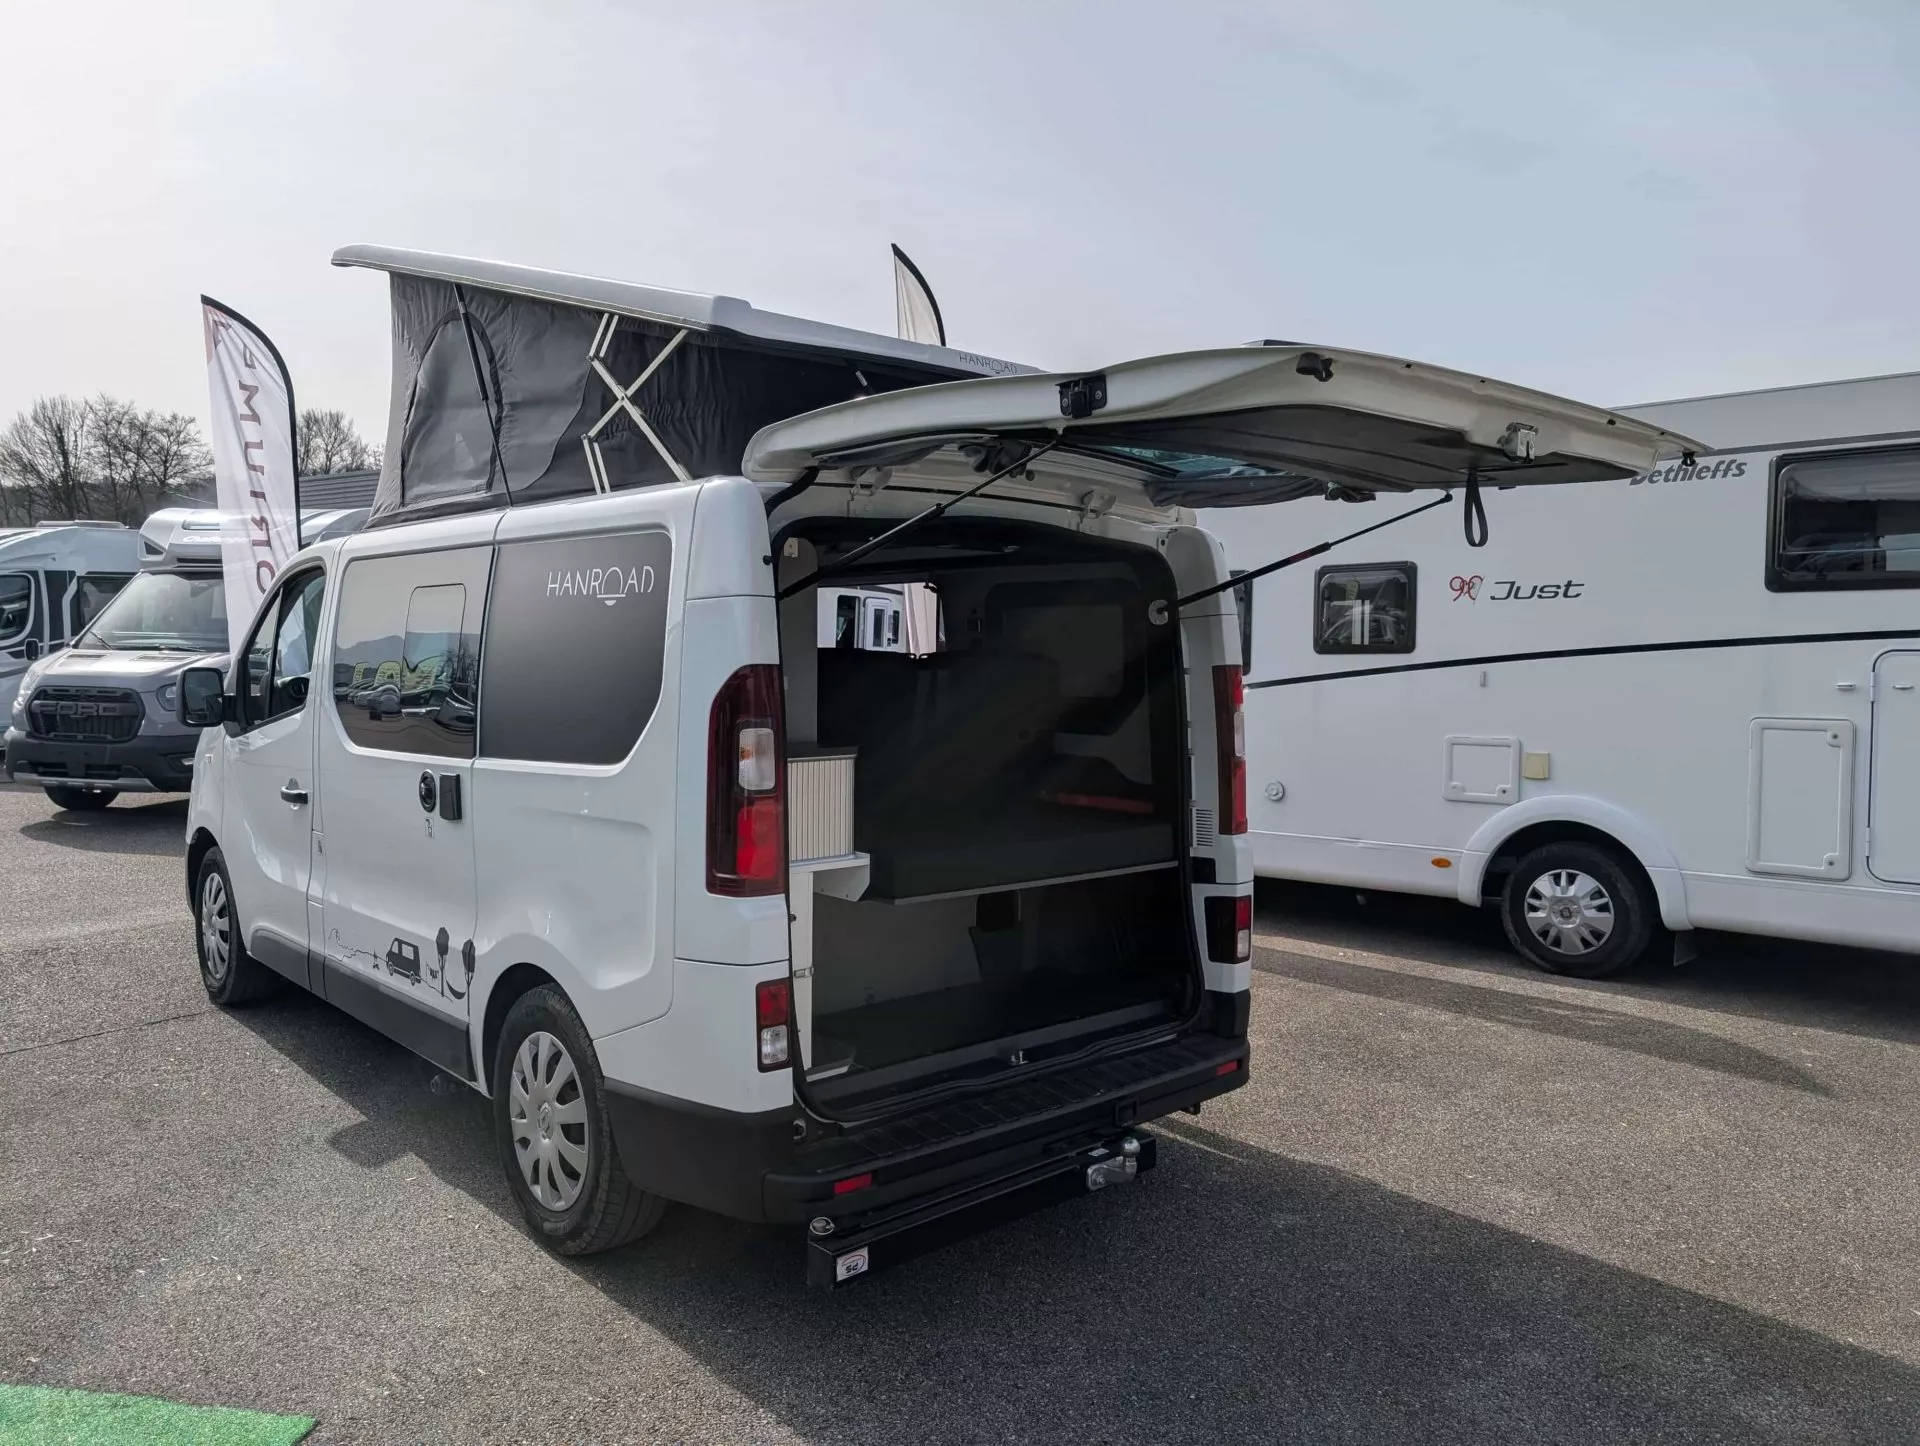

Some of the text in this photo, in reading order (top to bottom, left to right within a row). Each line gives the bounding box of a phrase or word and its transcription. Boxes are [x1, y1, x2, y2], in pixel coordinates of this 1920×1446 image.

[959, 351, 1018, 374] HANROAD
[546, 565, 655, 606] HANROAD
[1490, 580, 1585, 600] Just
[38, 701, 121, 716] FORD
